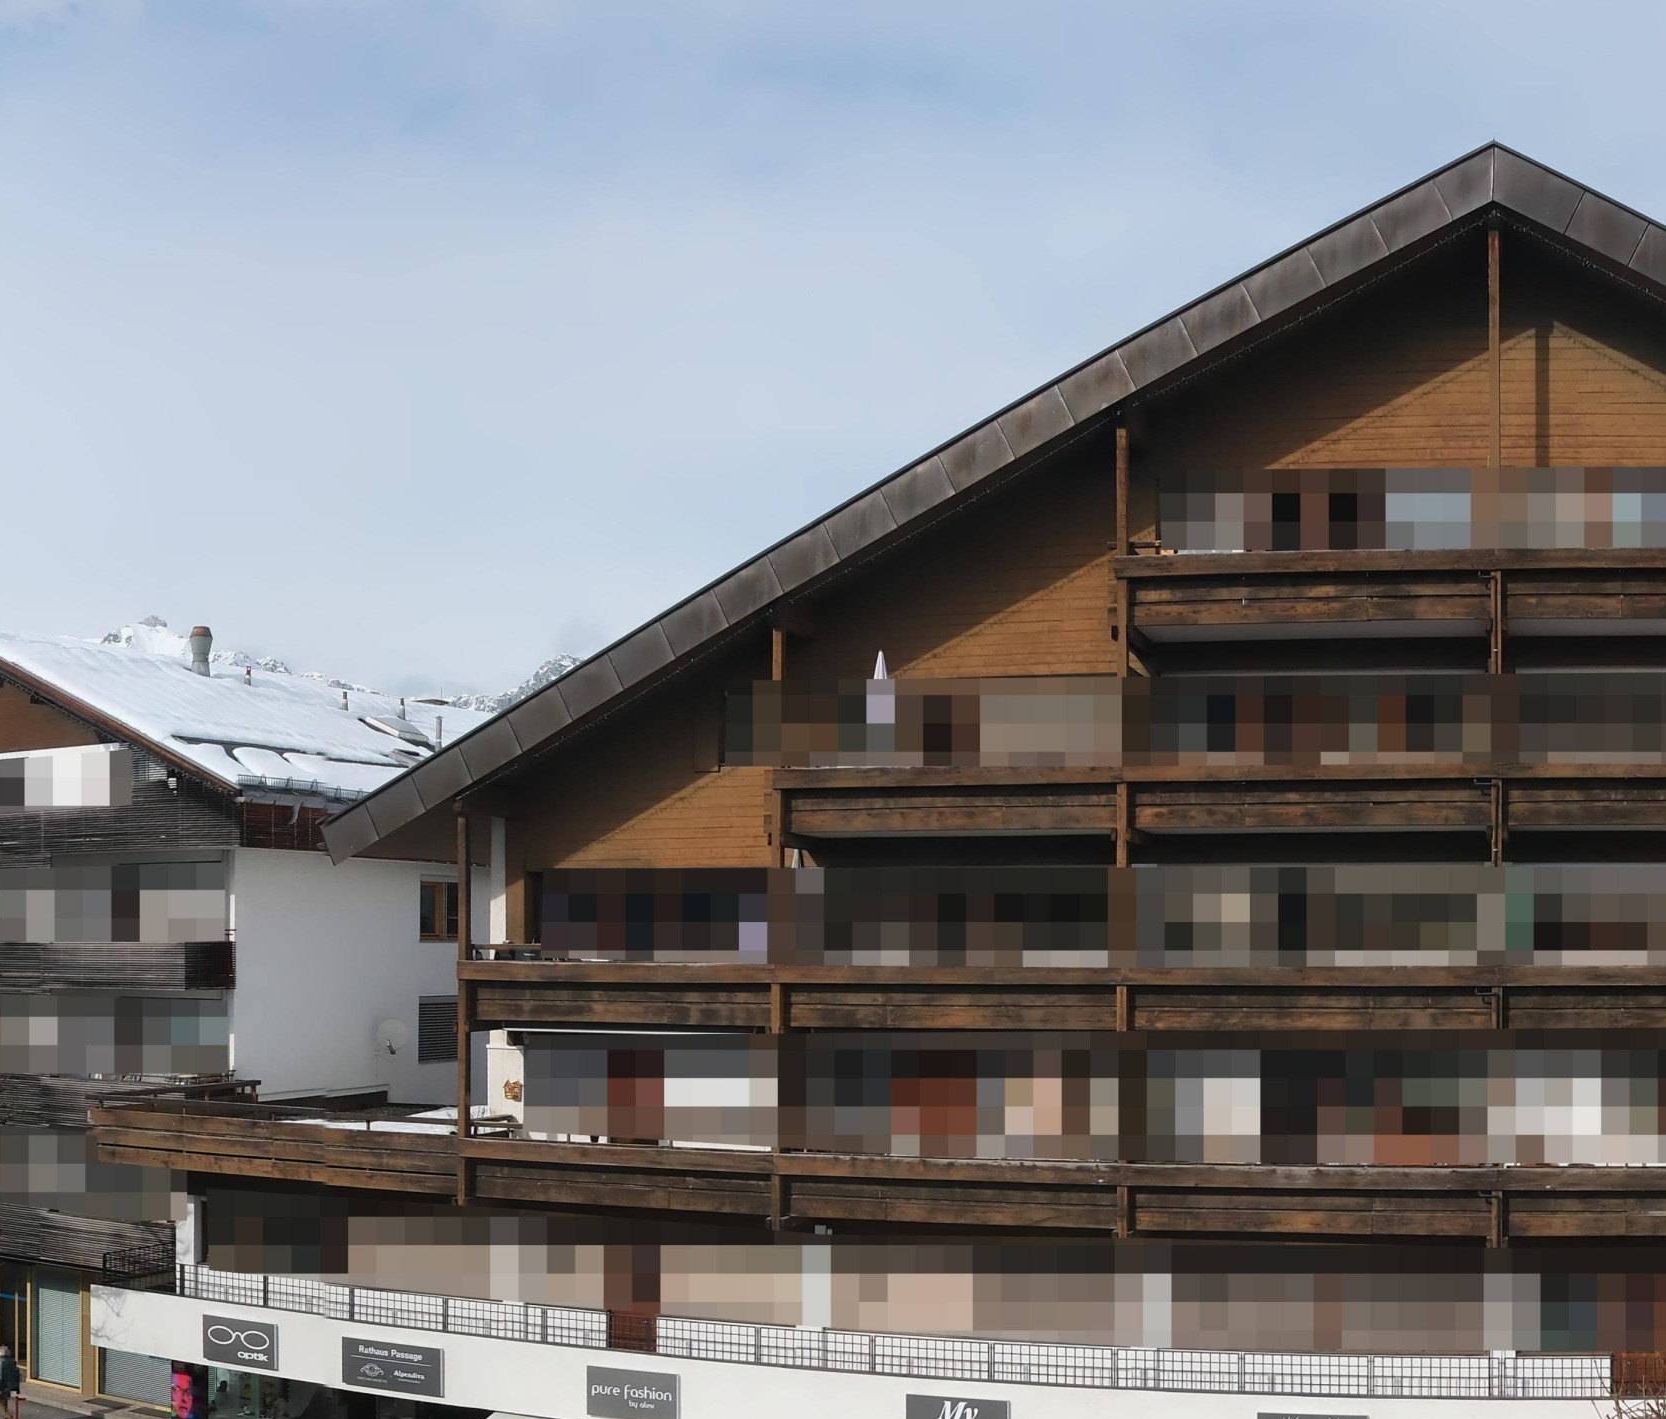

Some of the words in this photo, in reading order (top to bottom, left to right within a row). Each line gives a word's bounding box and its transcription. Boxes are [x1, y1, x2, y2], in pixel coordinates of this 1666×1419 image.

[237, 1351, 269, 1362] optik
[359, 1344, 388, 1357] Rathaus
[391, 1348, 423, 1362] Passage
[591, 1384, 621, 1397] pure
[624, 1384, 672, 1402] fashion
[628, 1400, 638, 1410] by
